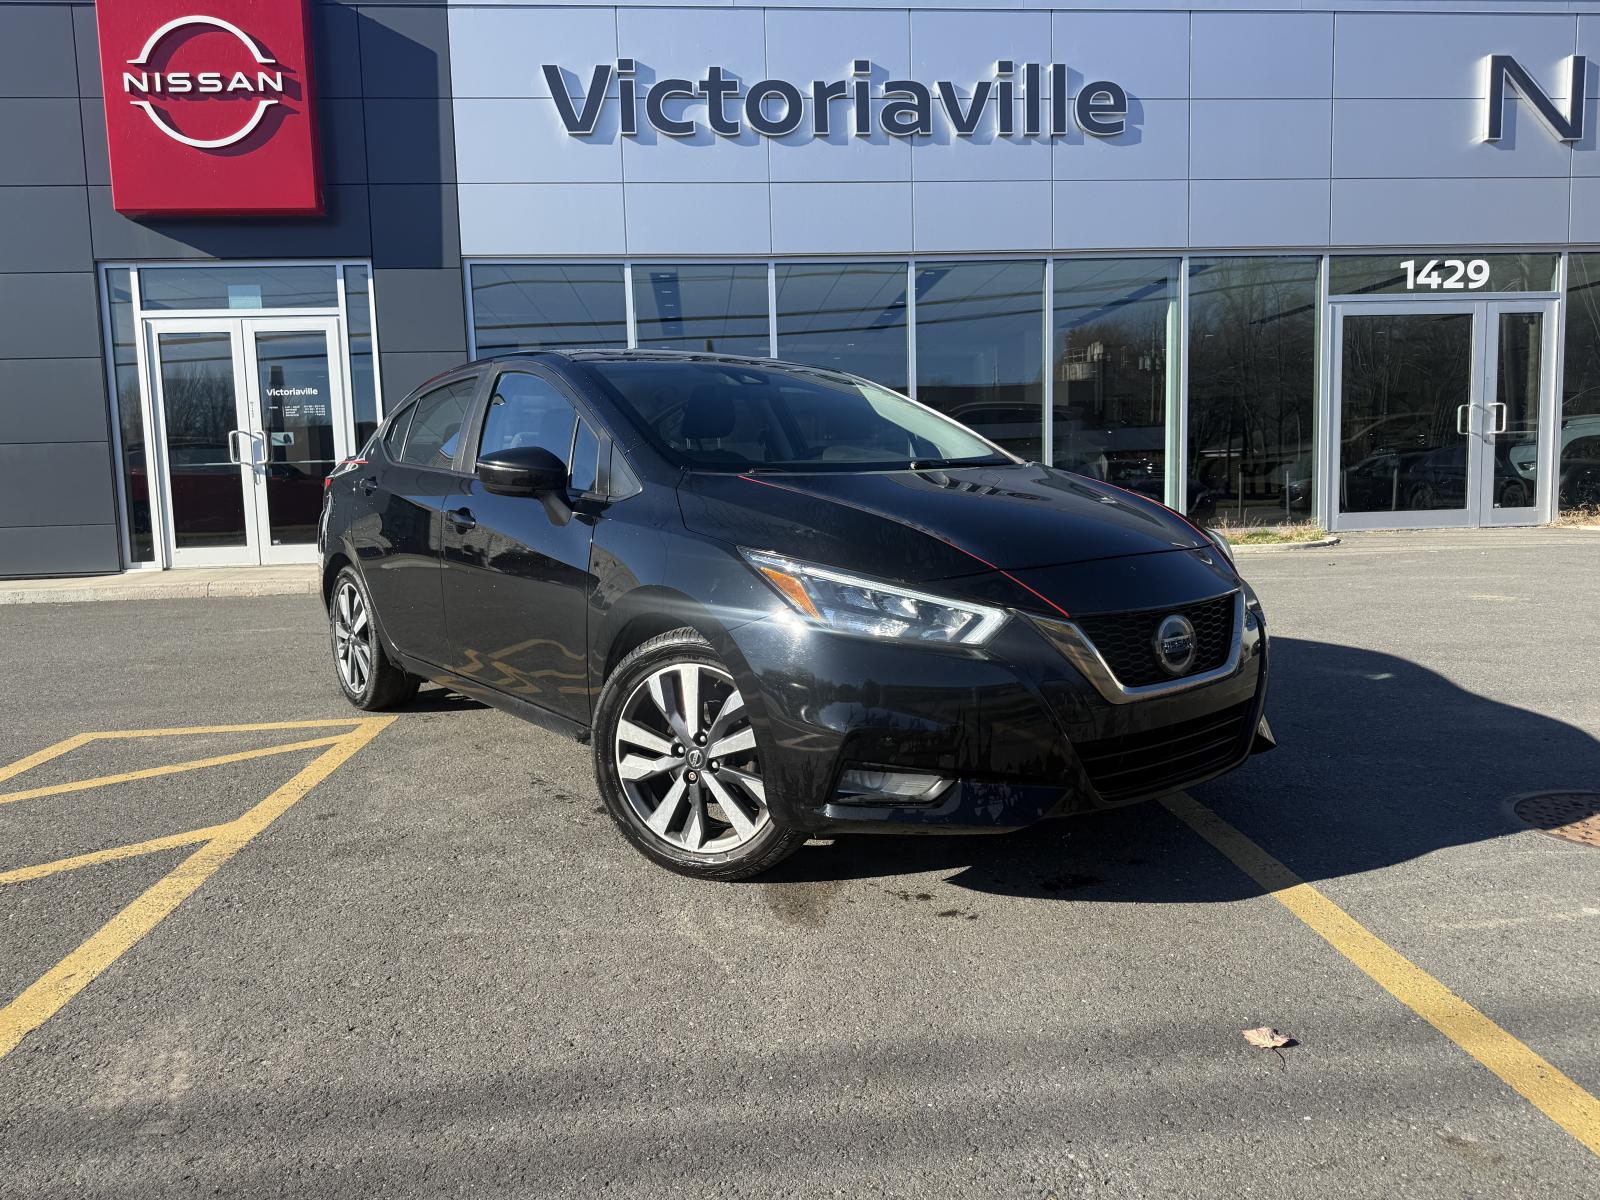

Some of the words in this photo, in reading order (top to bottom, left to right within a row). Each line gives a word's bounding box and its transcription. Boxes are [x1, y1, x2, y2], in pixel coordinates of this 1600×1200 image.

[123, 71, 284, 93] NISSAN
[542, 58, 1129, 137] Victoriaville
[1484, 54, 1586, 142] N
[1399, 259, 1490, 289] 1429
[266, 387, 318, 396] Victoriaville
